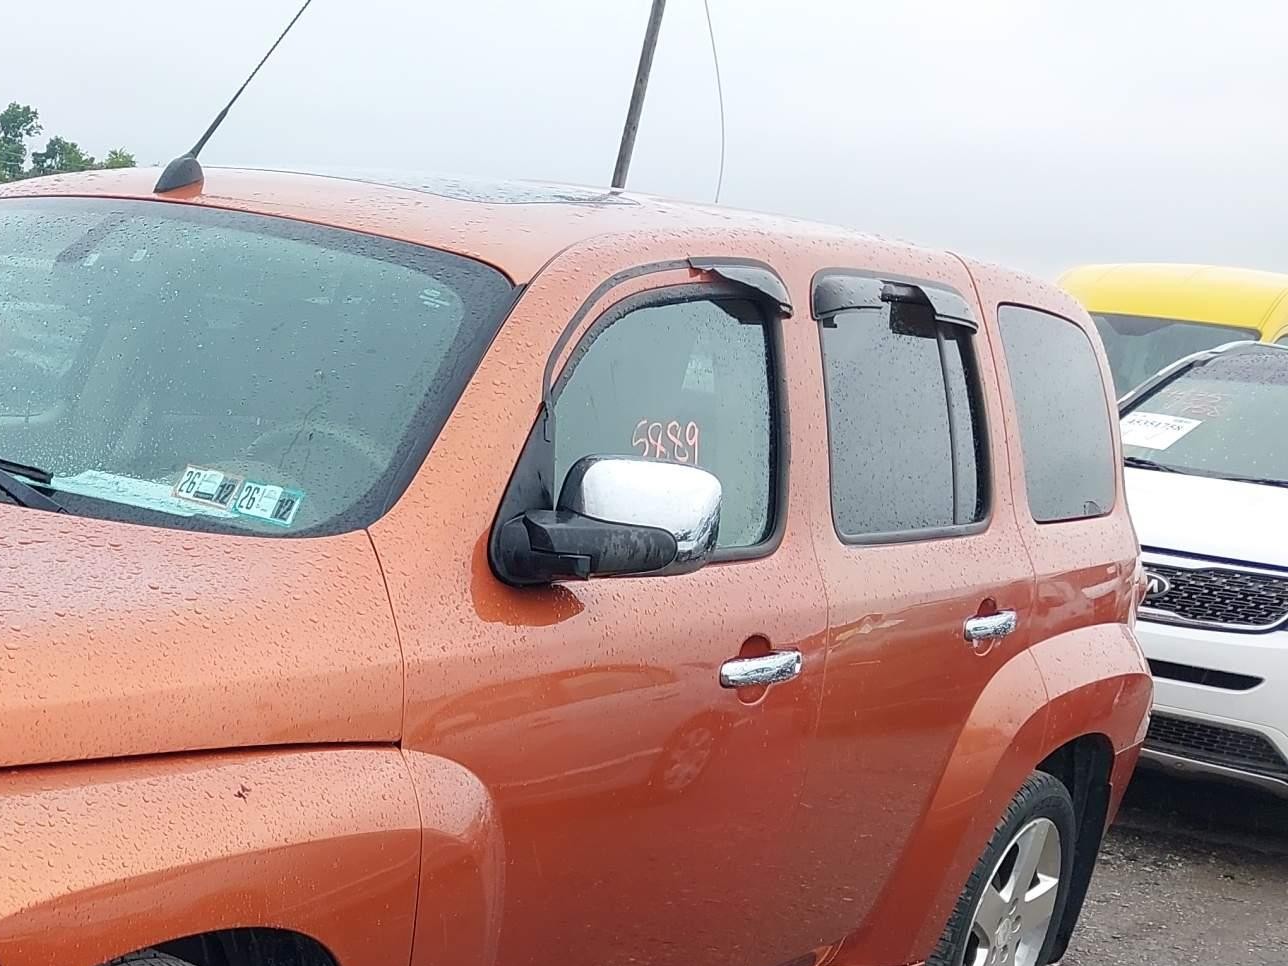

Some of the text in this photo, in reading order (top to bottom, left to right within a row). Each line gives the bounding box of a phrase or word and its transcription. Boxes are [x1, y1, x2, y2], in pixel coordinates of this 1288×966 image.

[632, 420, 698, 464] 5889
[179, 470, 235, 505] 26 12
[238, 485, 295, 521] 26 12
